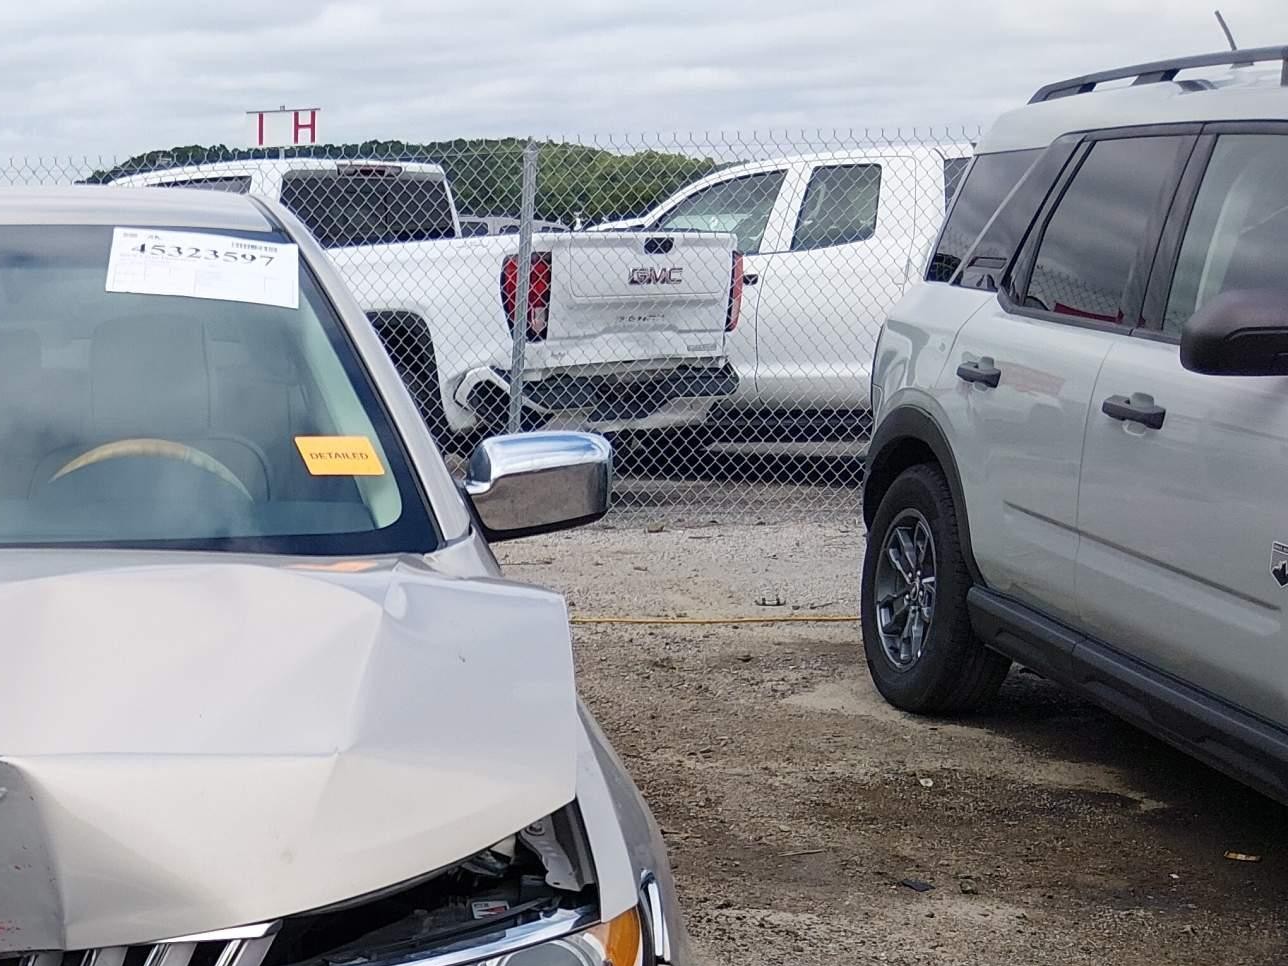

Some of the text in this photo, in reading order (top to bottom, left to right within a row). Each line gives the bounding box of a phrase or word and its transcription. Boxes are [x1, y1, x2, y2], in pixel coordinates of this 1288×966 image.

[130, 243, 275, 267] 45323597
[628, 267, 683, 285] GMC
[310, 452, 369, 460] DETAILED
